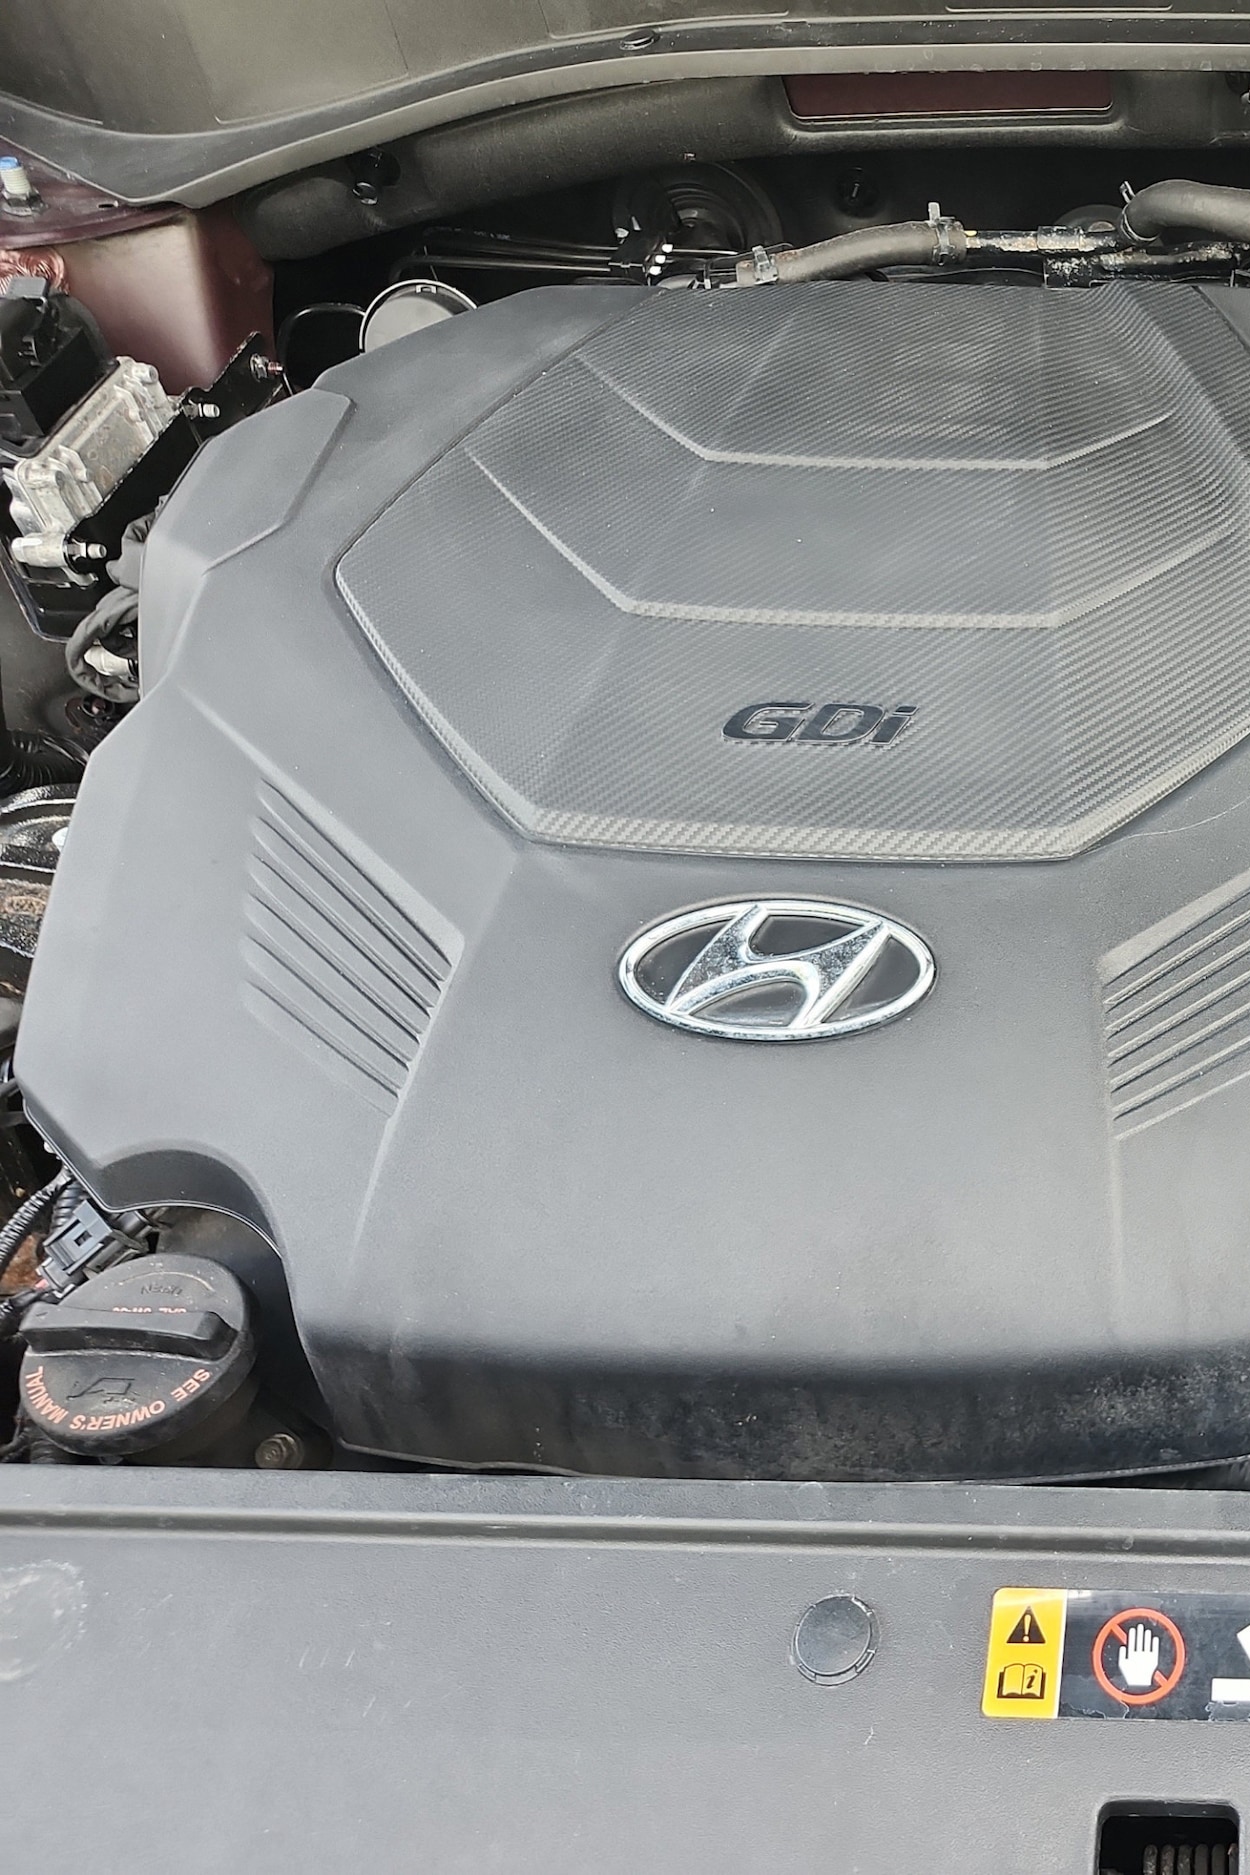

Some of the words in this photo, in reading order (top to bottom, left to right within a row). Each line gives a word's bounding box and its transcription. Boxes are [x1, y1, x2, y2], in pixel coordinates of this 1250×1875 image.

[721, 702, 920, 745] GDi
[25, 1366, 69, 1424] MANUAL
[170, 1368, 210, 1402] SEE
[69, 1400, 166, 1431] OWNER'S
